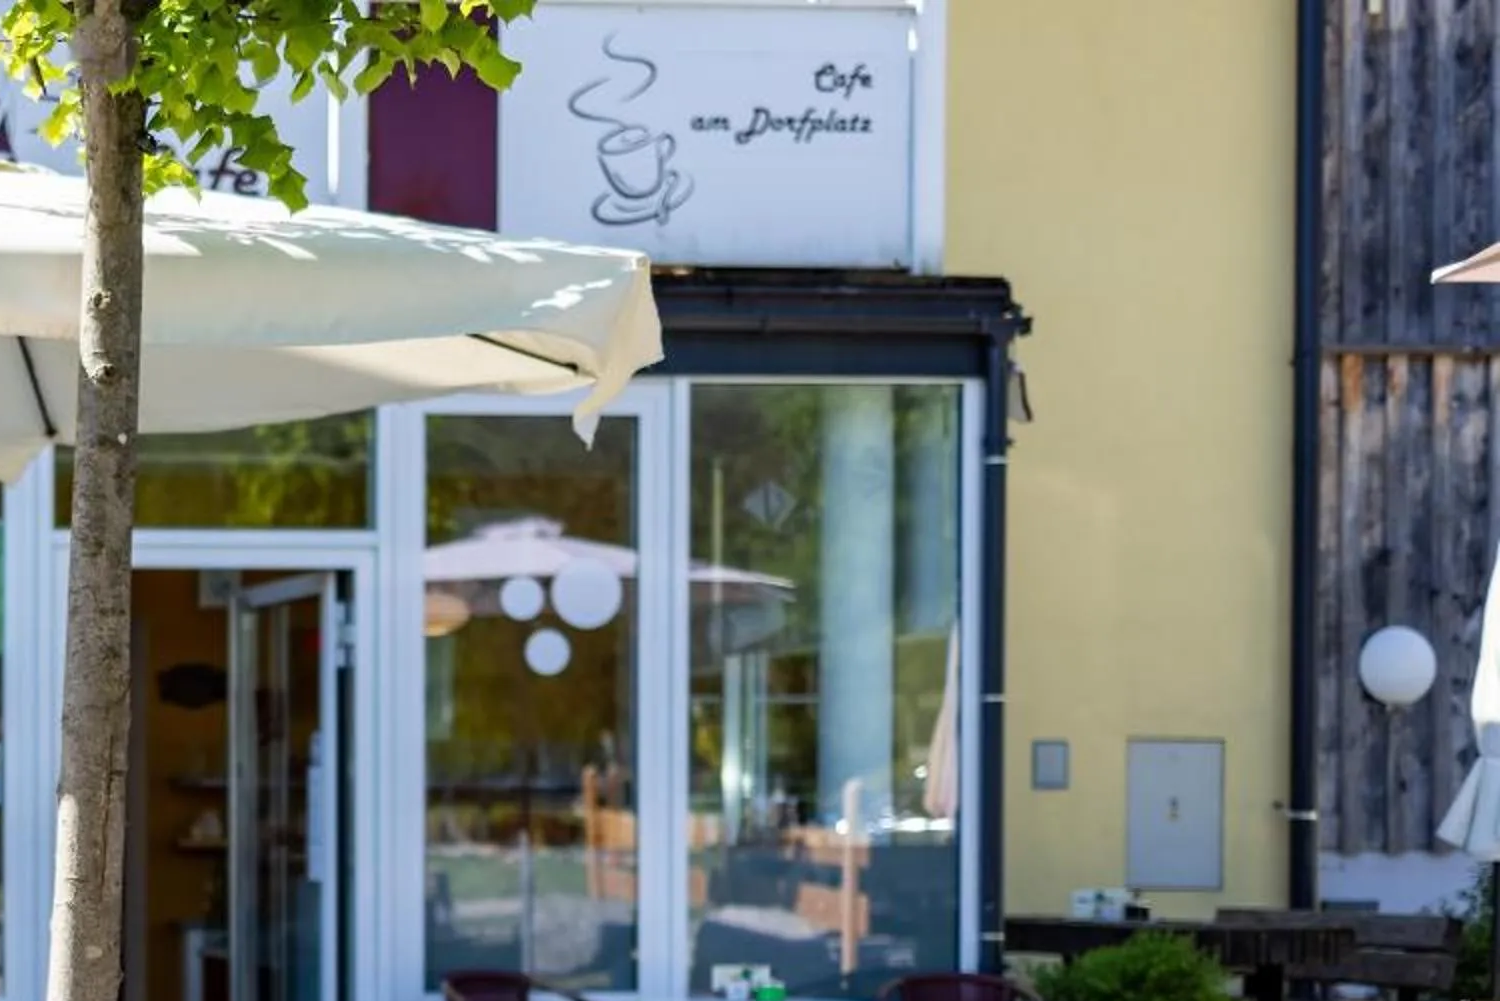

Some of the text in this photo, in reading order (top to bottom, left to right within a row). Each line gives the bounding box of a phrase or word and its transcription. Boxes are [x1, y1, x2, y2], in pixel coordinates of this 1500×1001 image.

[813, 62, 874, 99] Cafe
[691, 107, 873, 144] am Dorfplatz
